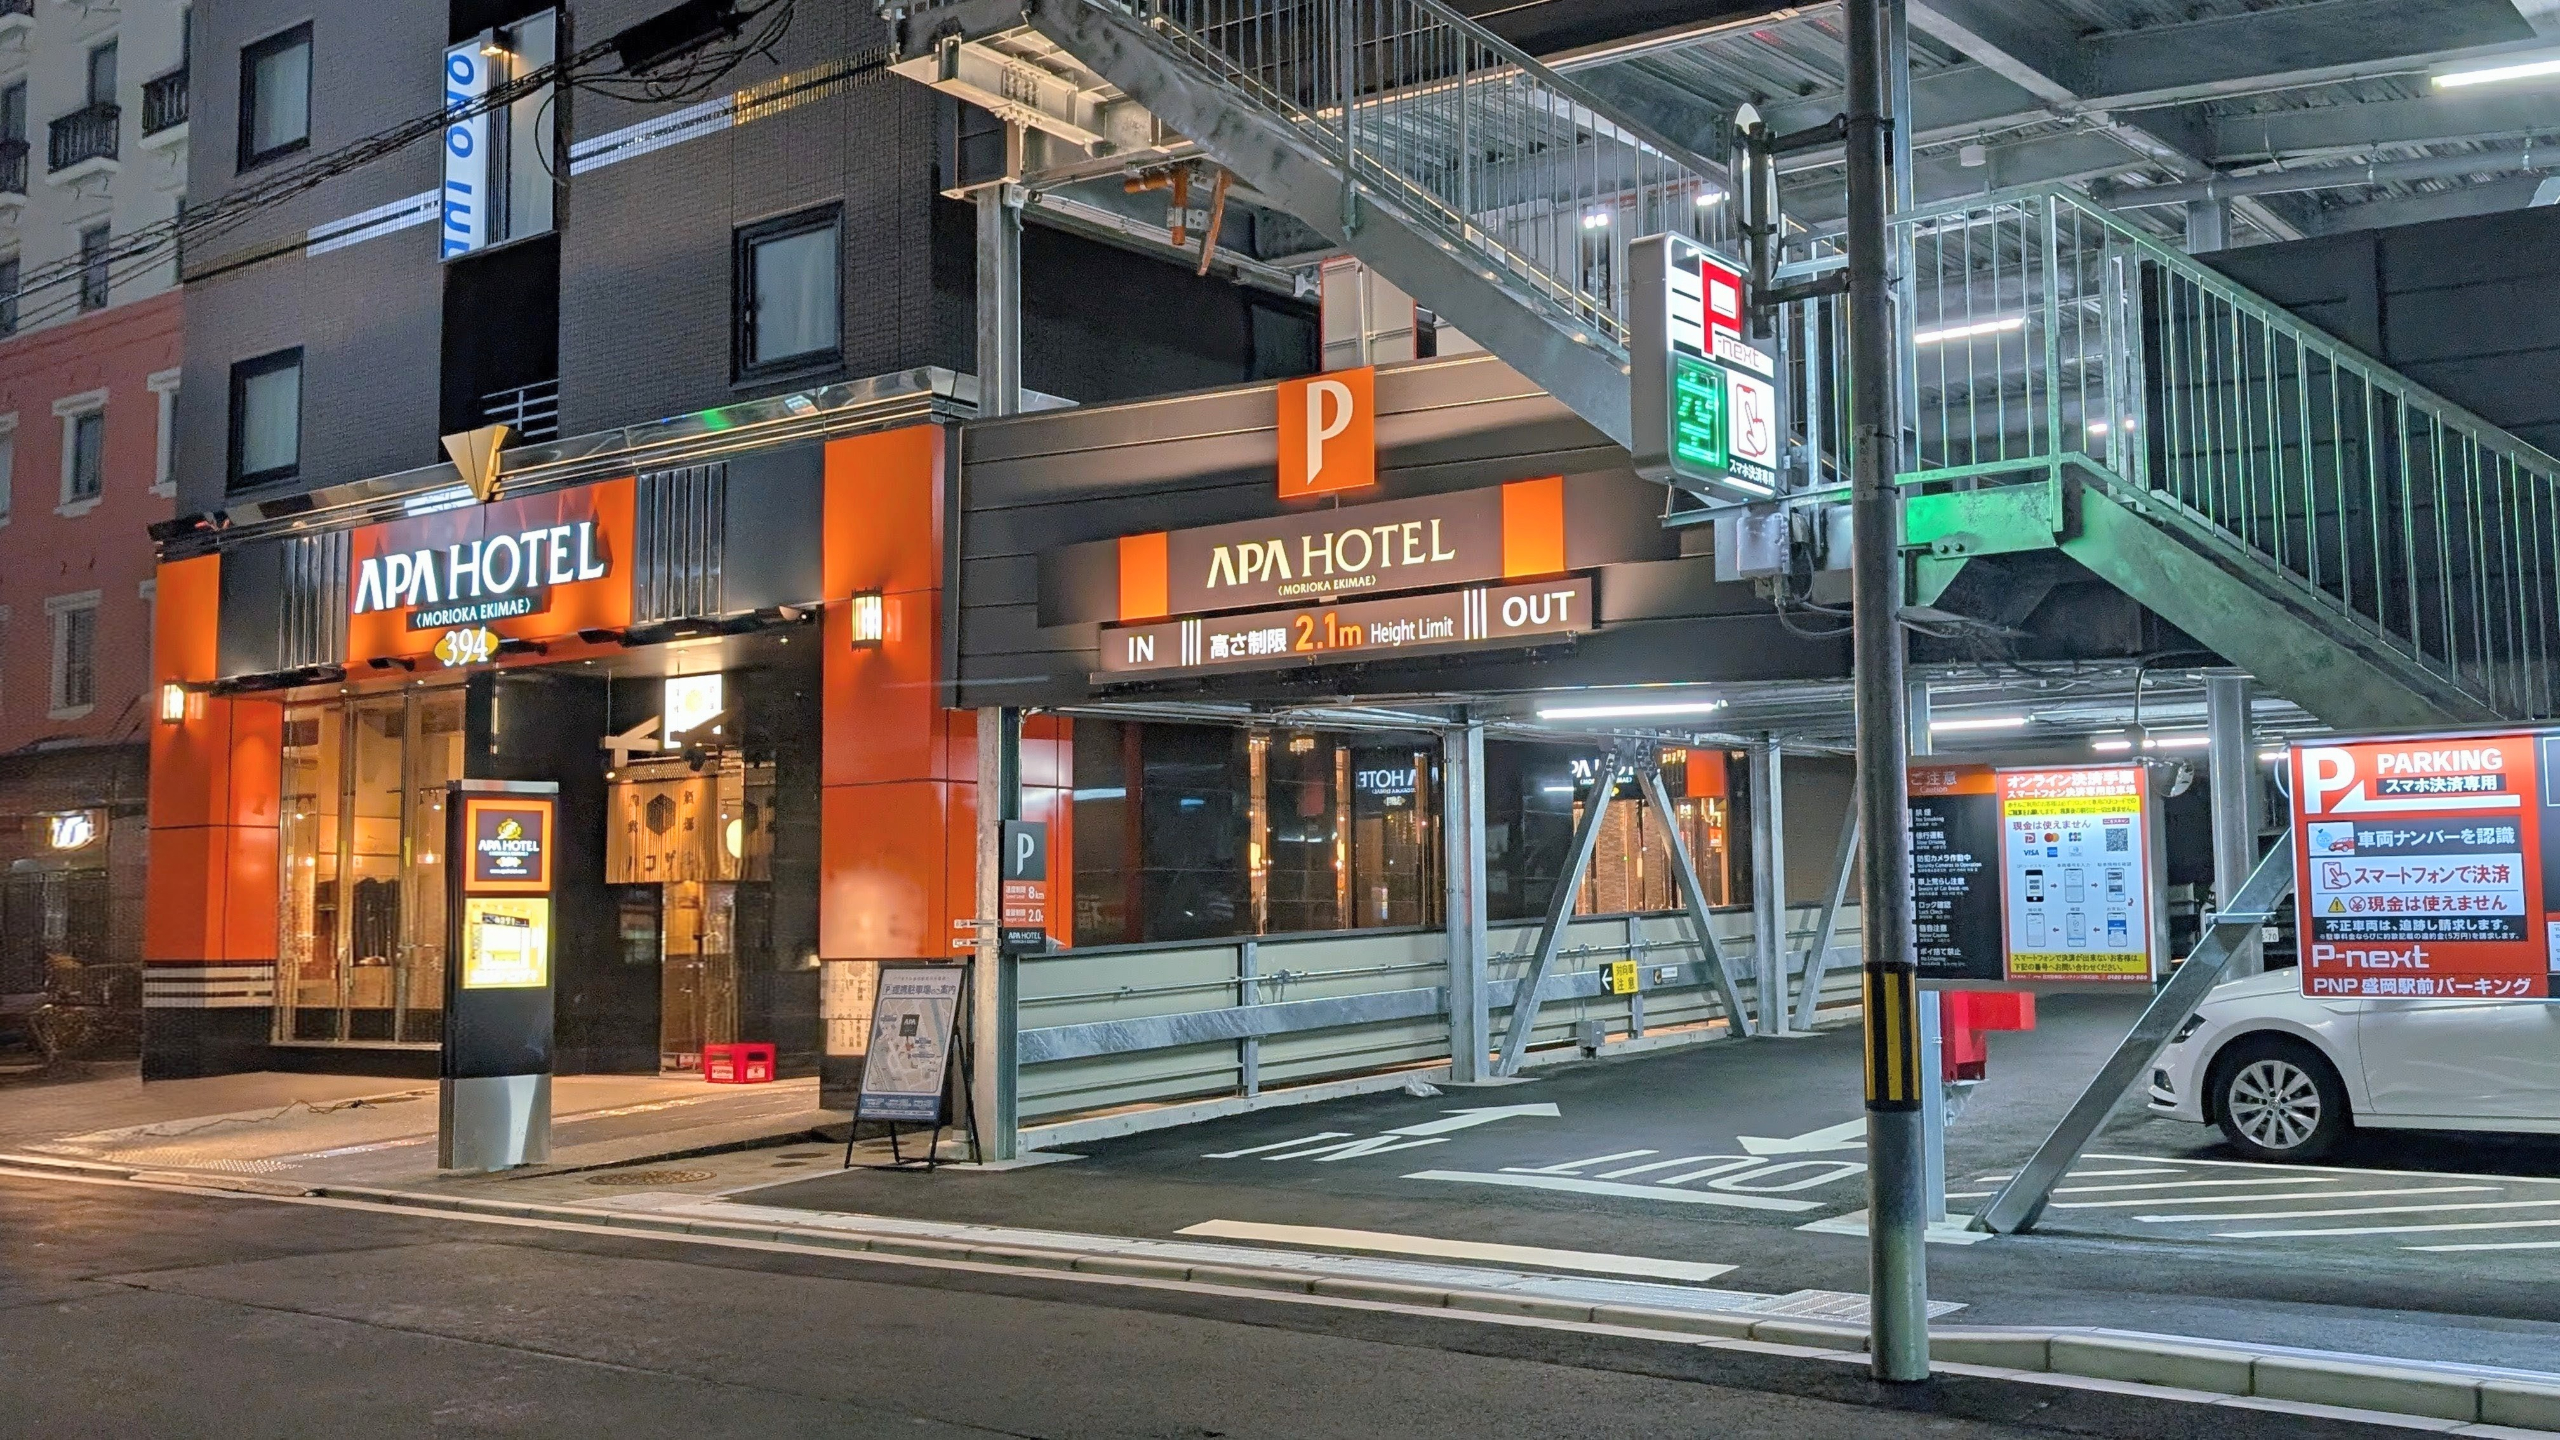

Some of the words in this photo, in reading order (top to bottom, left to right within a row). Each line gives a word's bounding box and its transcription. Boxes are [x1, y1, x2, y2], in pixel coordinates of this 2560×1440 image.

[1306, 380, 1353, 484] P
[1207, 545, 1290, 588] APA
[1302, 518, 1455, 576] HOTEL
[354, 549, 439, 613] APA
[448, 521, 604, 600] HOTEL
[1502, 590, 1575, 628] OUT
[443, 626, 489, 667] 394
[1127, 634, 1154, 662] IN
[1210, 628, 1287, 659] 高さ制限
[1294, 613, 1362, 652] 2.1m
[1370, 619, 1415, 647] Height
[1418, 616, 1453, 639] Limit
[2377, 748, 2503, 775] PARKING
[1911, 771, 1957, 786] ご注意
[2302, 747, 2356, 813] P
[2385, 774, 2498, 793] スマホ決済専用
[2012, 820, 2091, 831] 現金は使えません
[2357, 826, 2515, 848] 車両ナンバーを認識
[502, 839, 540, 852] HOTEL
[1017, 832, 1035, 876] P
[1916, 854, 1972, 863] 防犯カメラ作動中
[2354, 863, 2510, 885] スマートフォンで決済
[2367, 893, 2508, 911] 現金は使えません
[1021, 931, 1042, 940] HOTEL
[2325, 918, 2509, 933] 不正車両は、追跡し請求します。
[2311, 943, 2430, 969] P-next
[2313, 977, 2357, 994] PNP
[1201, 1132, 1451, 1162] IN
